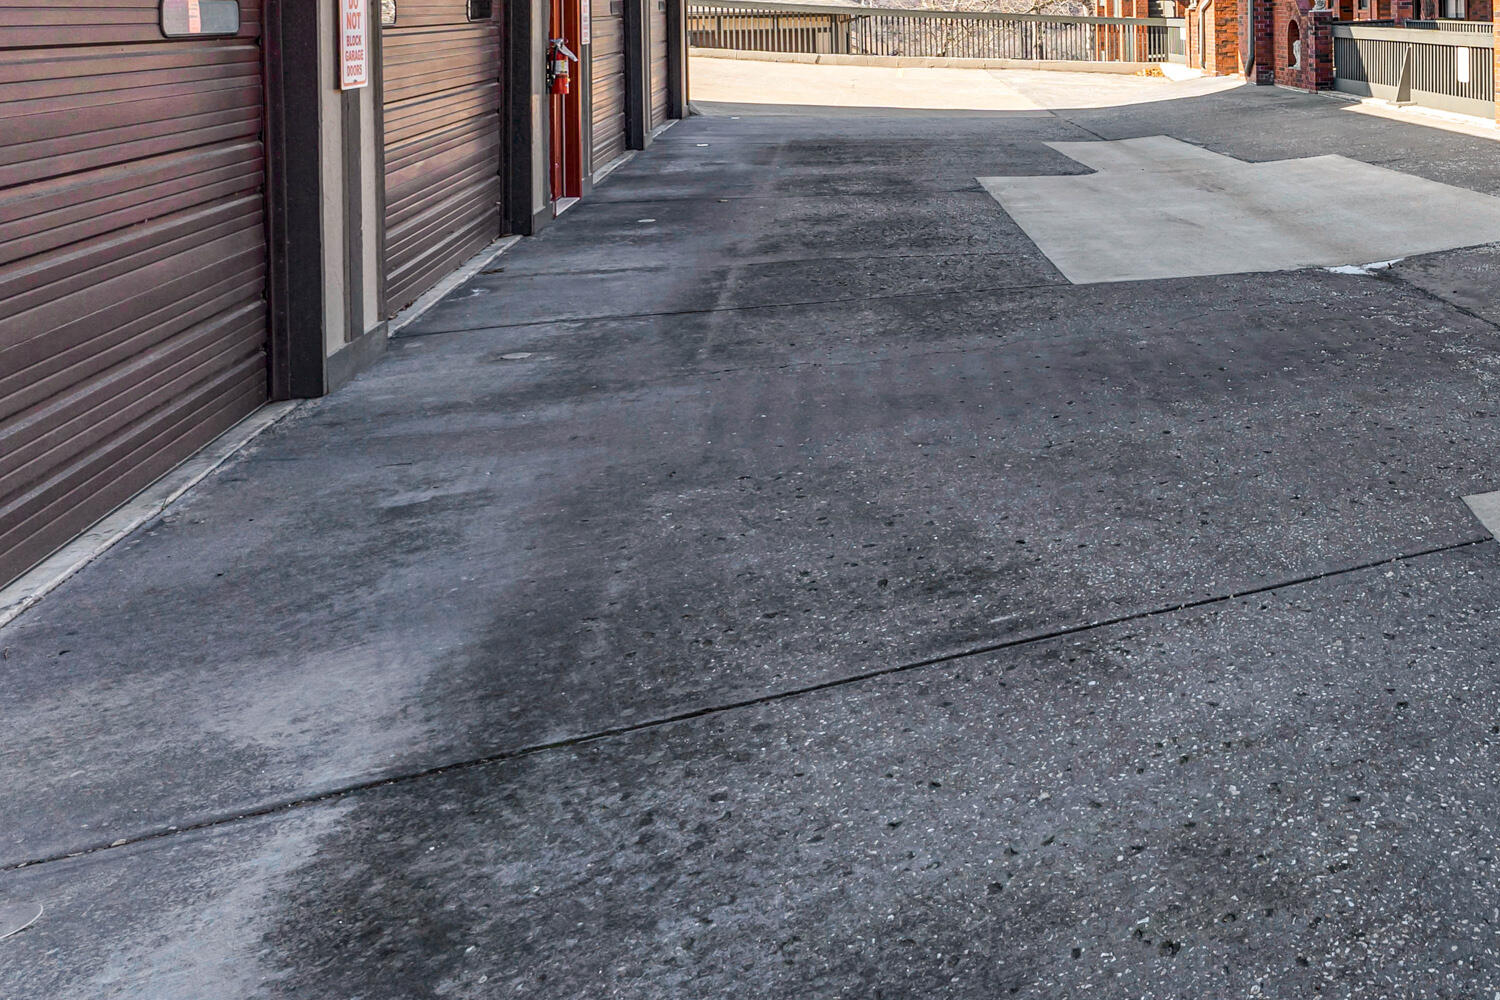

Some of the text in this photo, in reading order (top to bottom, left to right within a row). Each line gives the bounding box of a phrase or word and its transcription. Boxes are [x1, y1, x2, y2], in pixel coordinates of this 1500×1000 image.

[346, 12, 361, 30] NOT
[346, 35, 362, 47] BLOCK
[345, 49, 364, 62] GARAGE
[346, 64, 362, 77] DOORS
